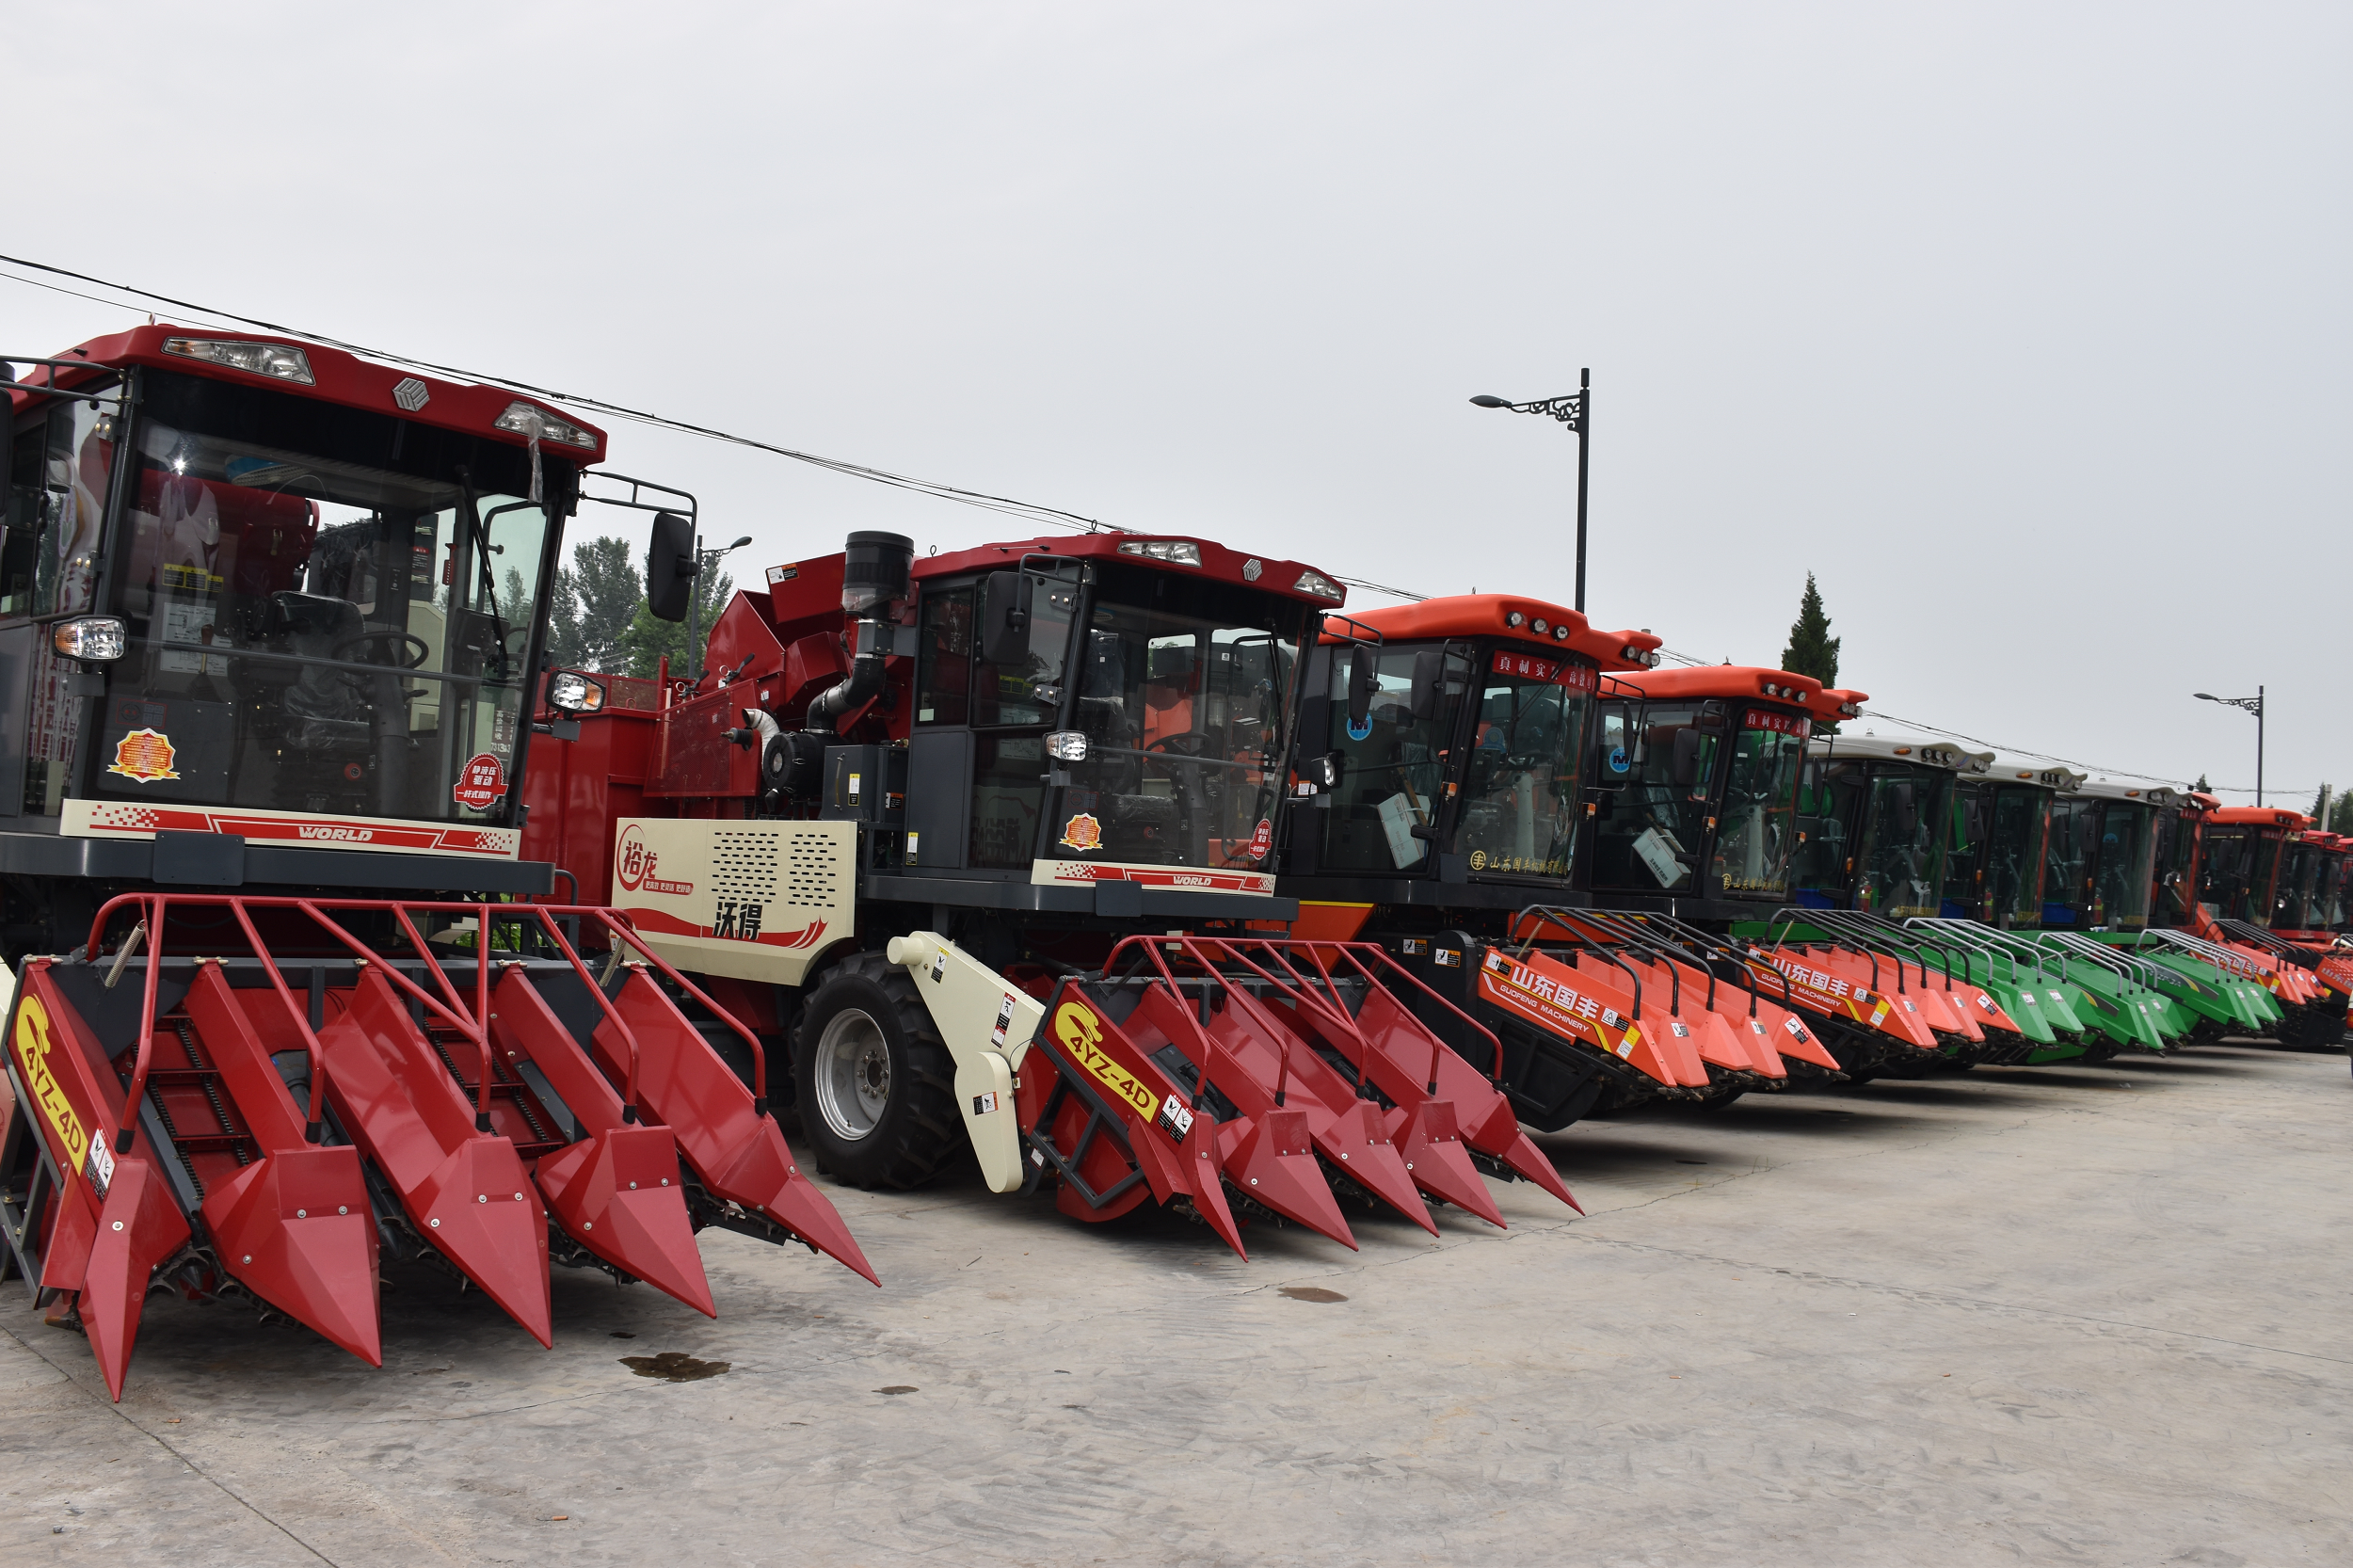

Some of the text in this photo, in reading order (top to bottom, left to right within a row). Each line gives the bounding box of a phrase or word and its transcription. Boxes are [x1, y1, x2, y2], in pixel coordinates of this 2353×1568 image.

[472, 775, 493, 786] 驱动
[298, 826, 374, 841] WORLD
[623, 840, 658, 879] 裕龙
[1173, 875, 1212, 887] WORLD
[712, 902, 763, 940] 沃得
[1511, 966, 1600, 1019] 山东国丰
[1771, 958, 1849, 997] 山东国丰
[1798, 986, 1842, 1007] MACHINERY
[1499, 984, 1538, 1008] GUOFENG
[1540, 1004, 1590, 1032] MACHINERY
[1069, 1035, 1150, 1109] 4YZ-4D
[25, 1046, 82, 1154] 4YZ-4D
